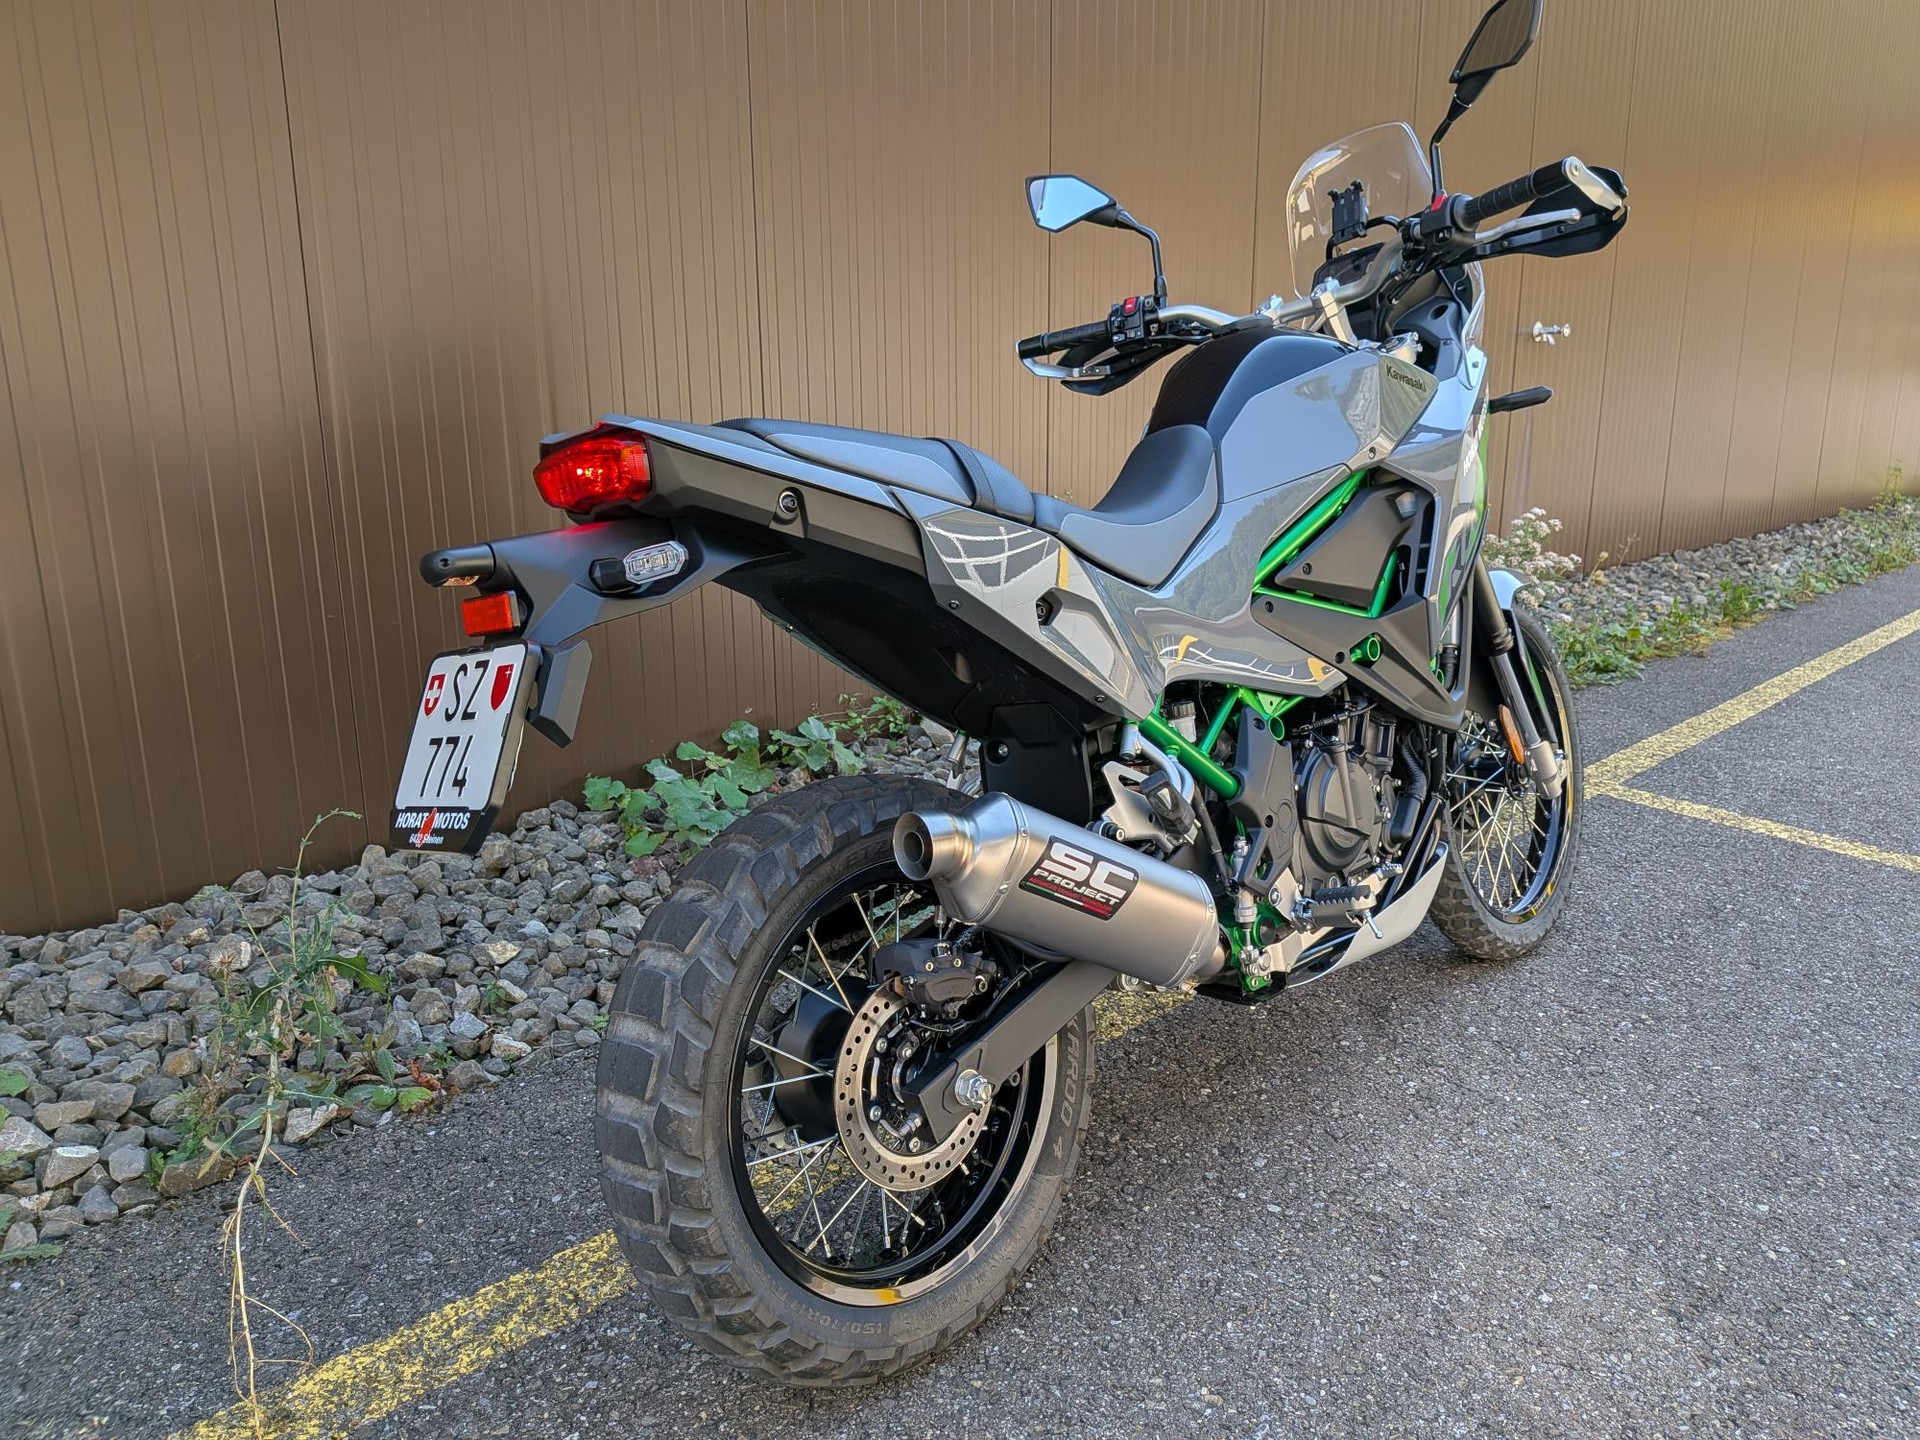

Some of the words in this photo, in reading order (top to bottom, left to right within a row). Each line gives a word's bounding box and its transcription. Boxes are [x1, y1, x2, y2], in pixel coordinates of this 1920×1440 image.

[1386, 364, 1427, 392] Kawasaki
[445, 659, 490, 722] SZ
[420, 735, 473, 798] 774
[395, 813, 428, 829] HORAT
[434, 812, 470, 830] MOTOS
[1033, 869, 1120, 906] PROJECT
[1041, 842, 1135, 899] SC
[1052, 1135, 1063, 1160] 4
